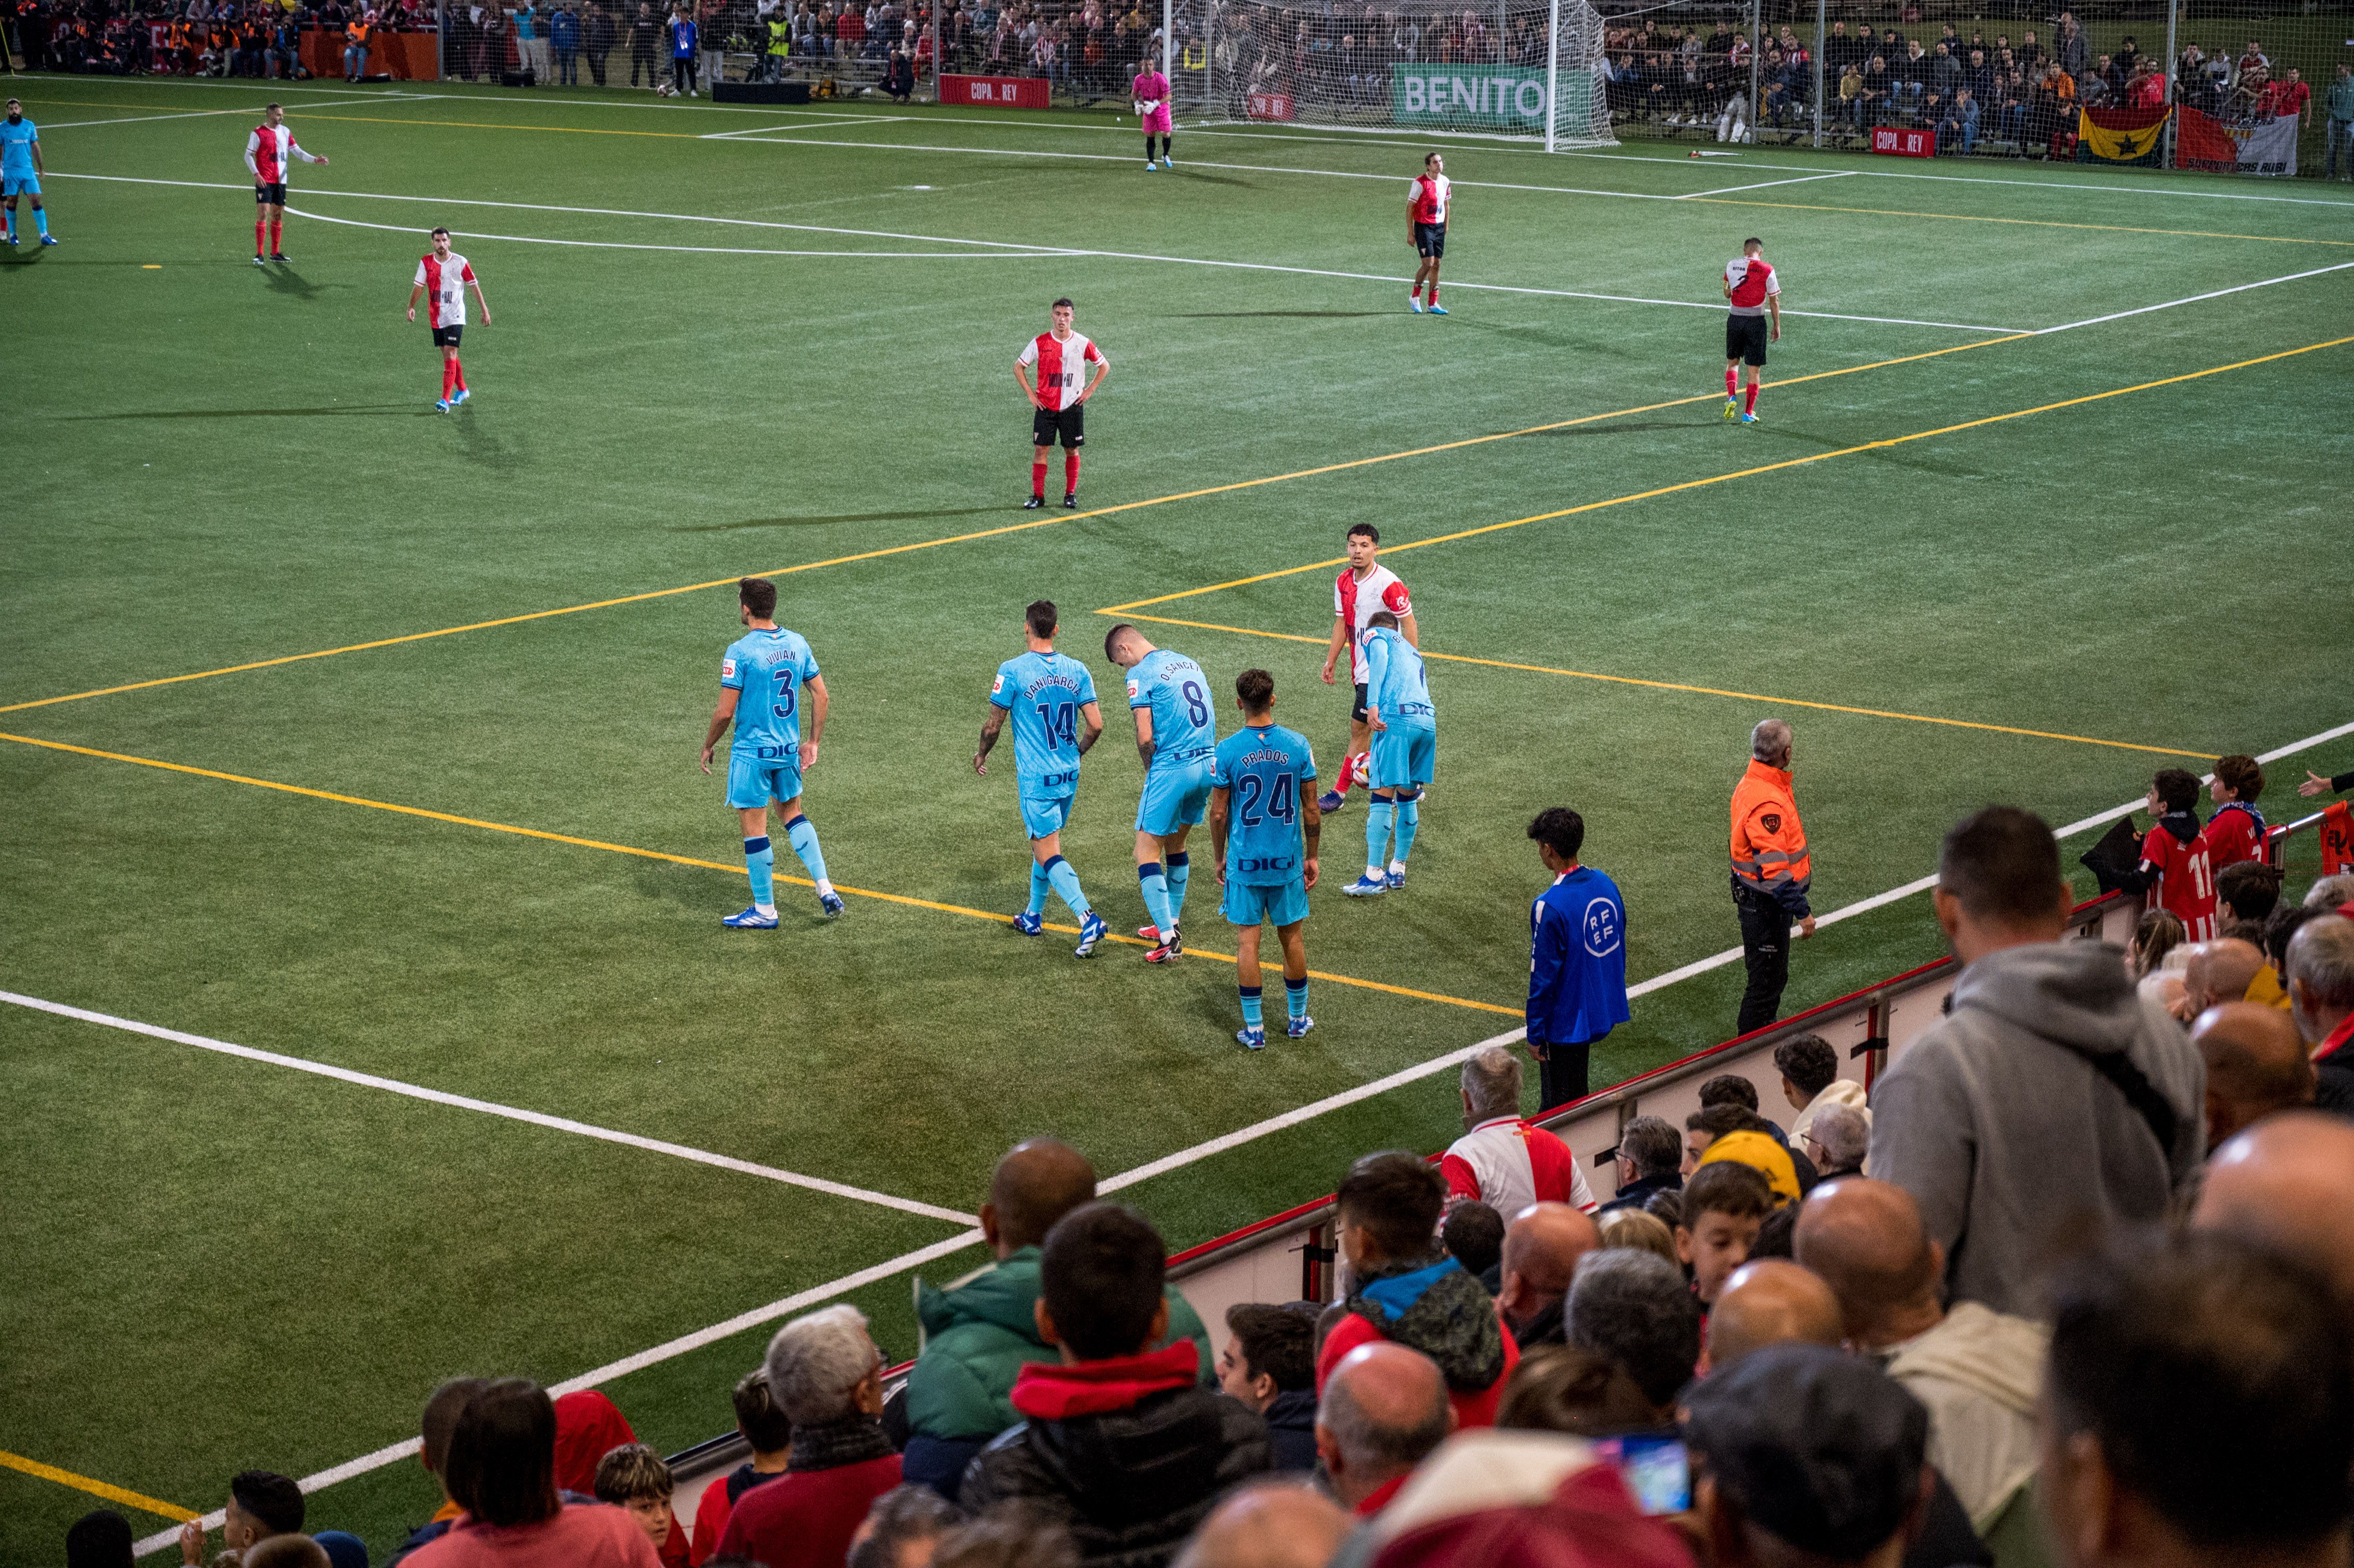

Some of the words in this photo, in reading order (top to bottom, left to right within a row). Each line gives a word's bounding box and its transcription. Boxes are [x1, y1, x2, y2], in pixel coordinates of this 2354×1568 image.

[971, 82, 992, 100] COPA
[1002, 84, 1017, 101] REY
[1404, 76, 1546, 117] BENITO
[1877, 131, 1897, 150] COPA
[1907, 134, 1923, 152] REY
[2187, 158, 2258, 173] SUPPORTERS
[2259, 162, 2287, 173] RUBI
[766, 650, 796, 665] VIVIAN
[773, 669, 796, 719] 3
[1182, 680, 1209, 728] 8
[1035, 701, 1076, 751] 14
[1241, 749, 1289, 768] PRADOS
[1238, 773, 1296, 828] 24
[2188, 850, 2213, 899] 11
